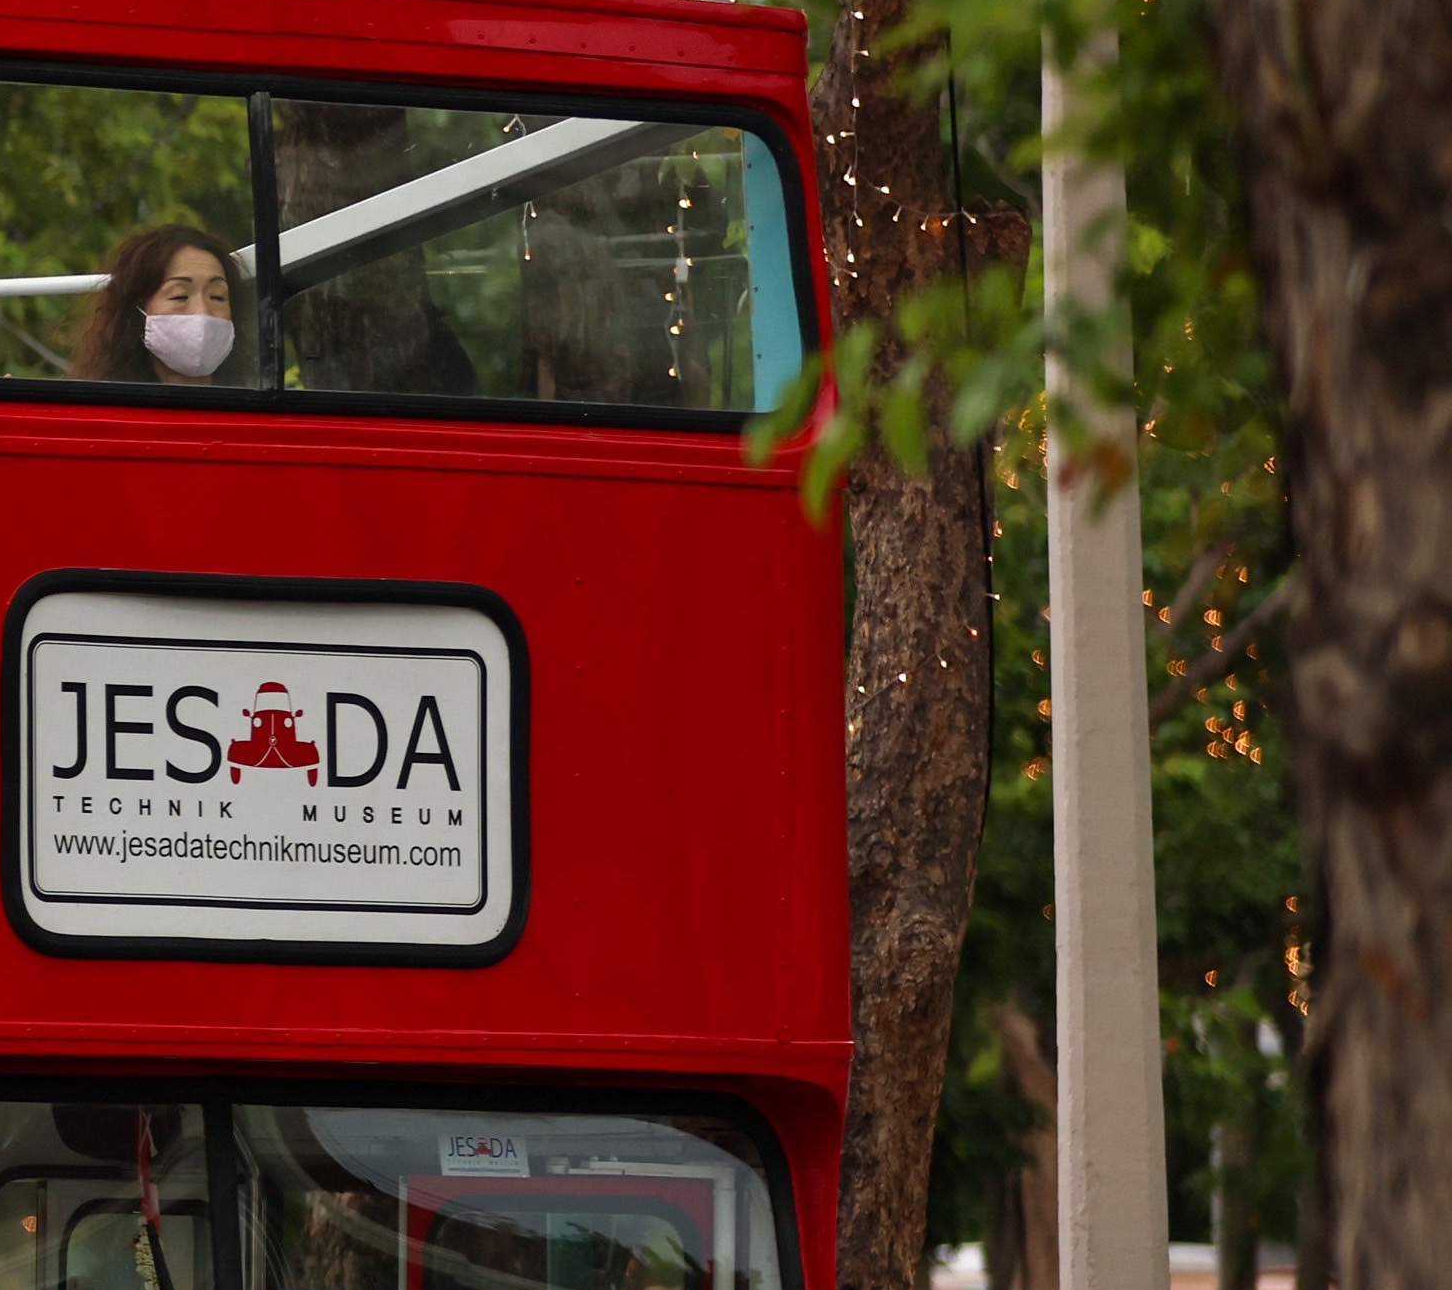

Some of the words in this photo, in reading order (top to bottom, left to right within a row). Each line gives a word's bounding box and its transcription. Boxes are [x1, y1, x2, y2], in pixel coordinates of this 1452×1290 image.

[52, 794, 235, 820] TECHNIK
[302, 804, 464, 827] MUSEUM
[53, 831, 462, 868] www.jesadatechnikmuseum.com
